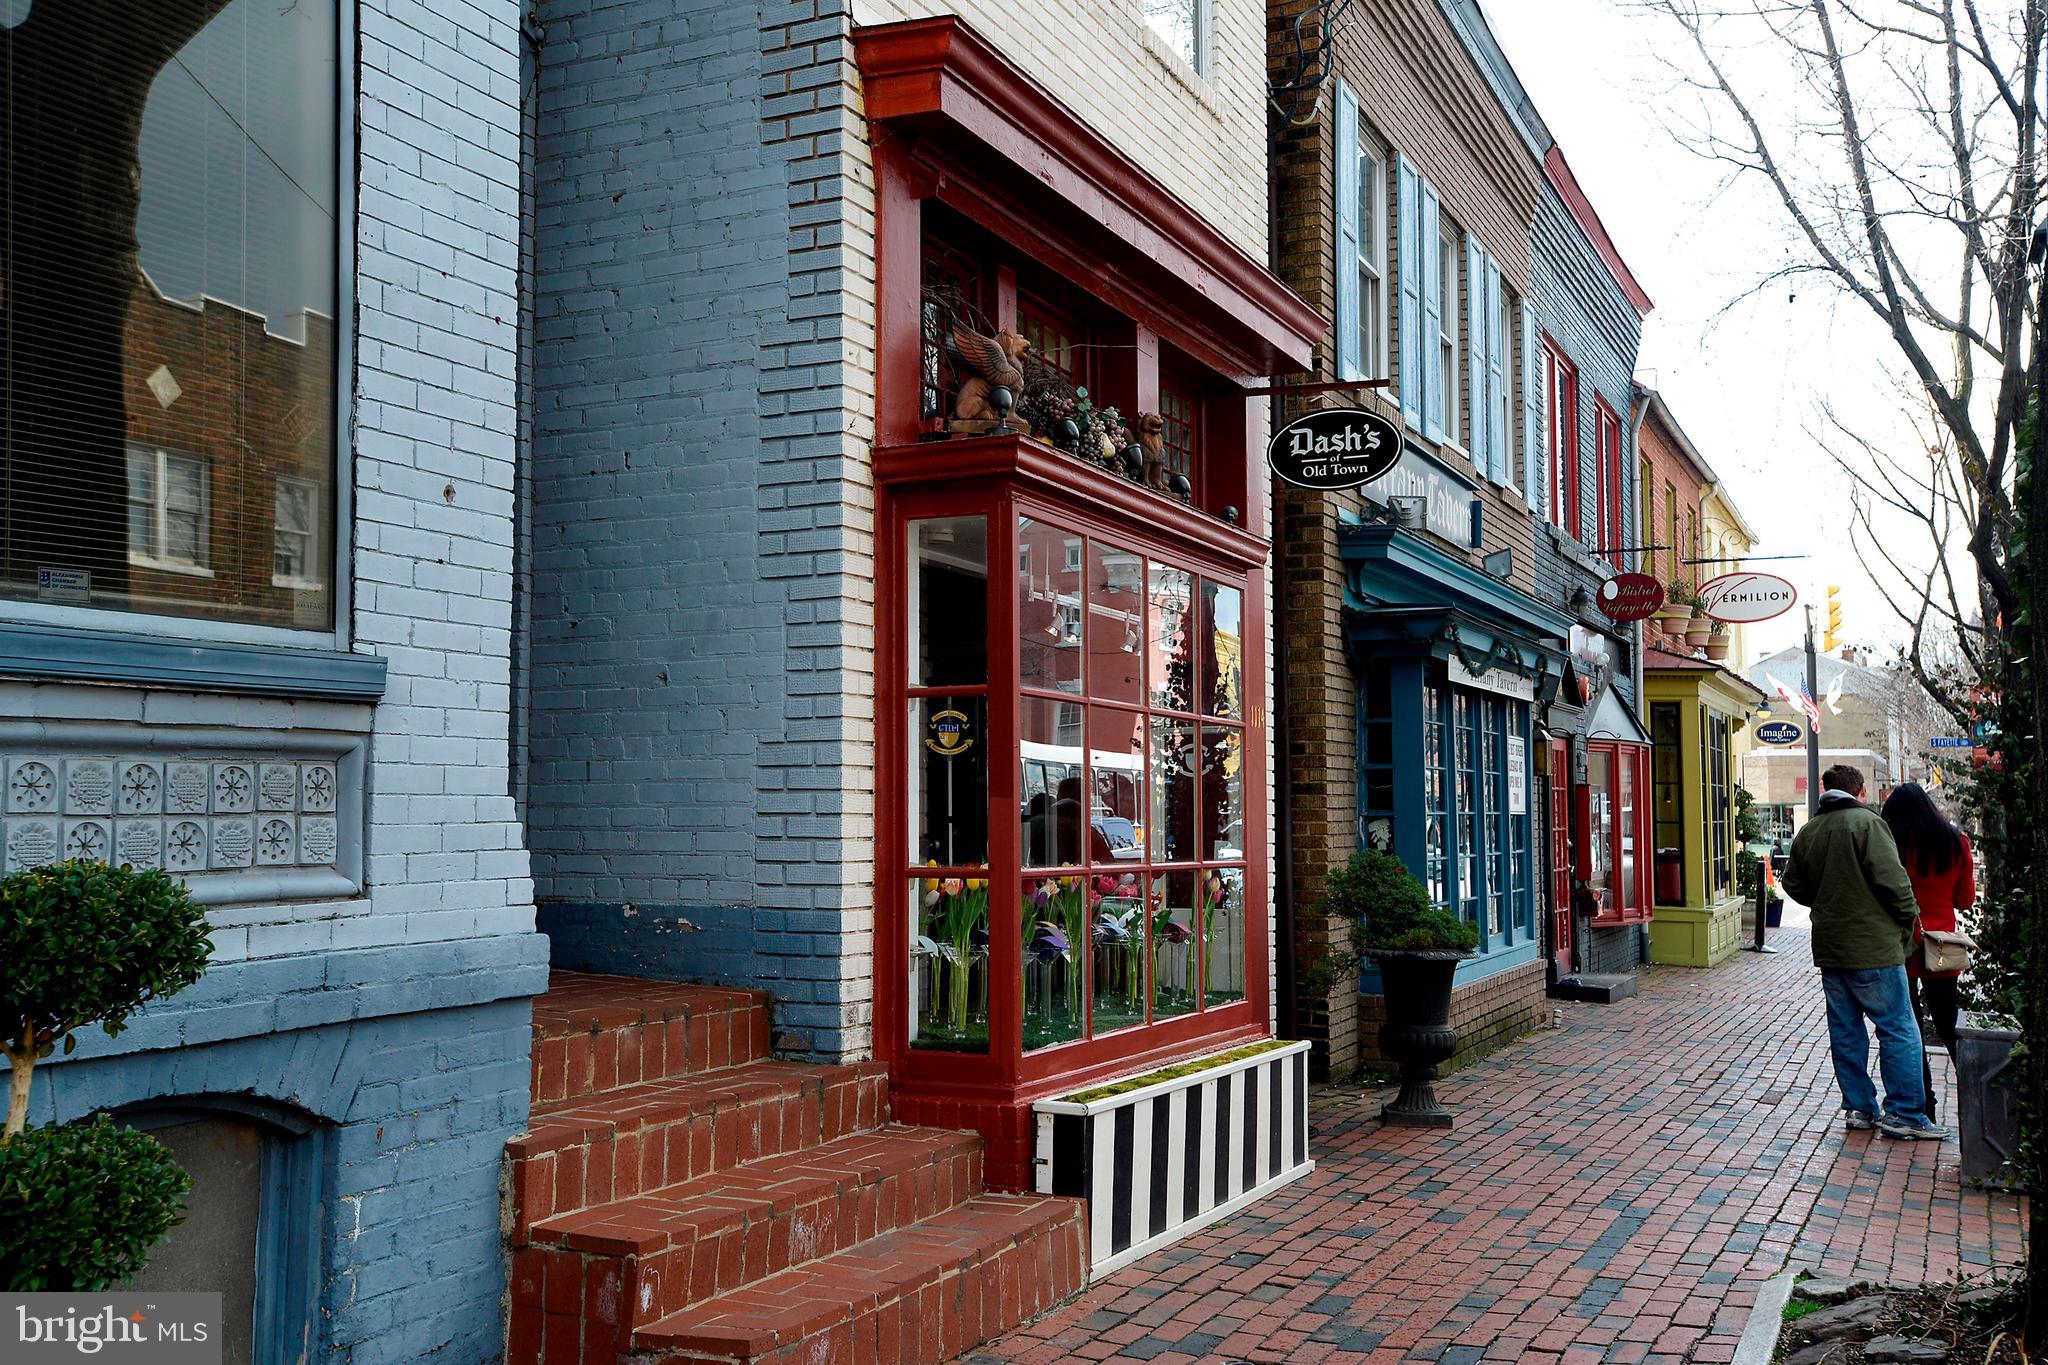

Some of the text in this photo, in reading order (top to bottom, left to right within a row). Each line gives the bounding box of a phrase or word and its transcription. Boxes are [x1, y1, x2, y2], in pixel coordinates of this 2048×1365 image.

[1289, 423, 1381, 457] Dash's
[1330, 454, 1341, 462] of
[1303, 464, 1369, 478] Old Town
[1619, 584, 1658, 596] Bistrot
[1702, 577, 1789, 612] VERMILION
[1603, 601, 1656, 616] Lafayette
[1497, 672, 1518, 693] Tavern
[1760, 726, 1797, 739] Imagine
